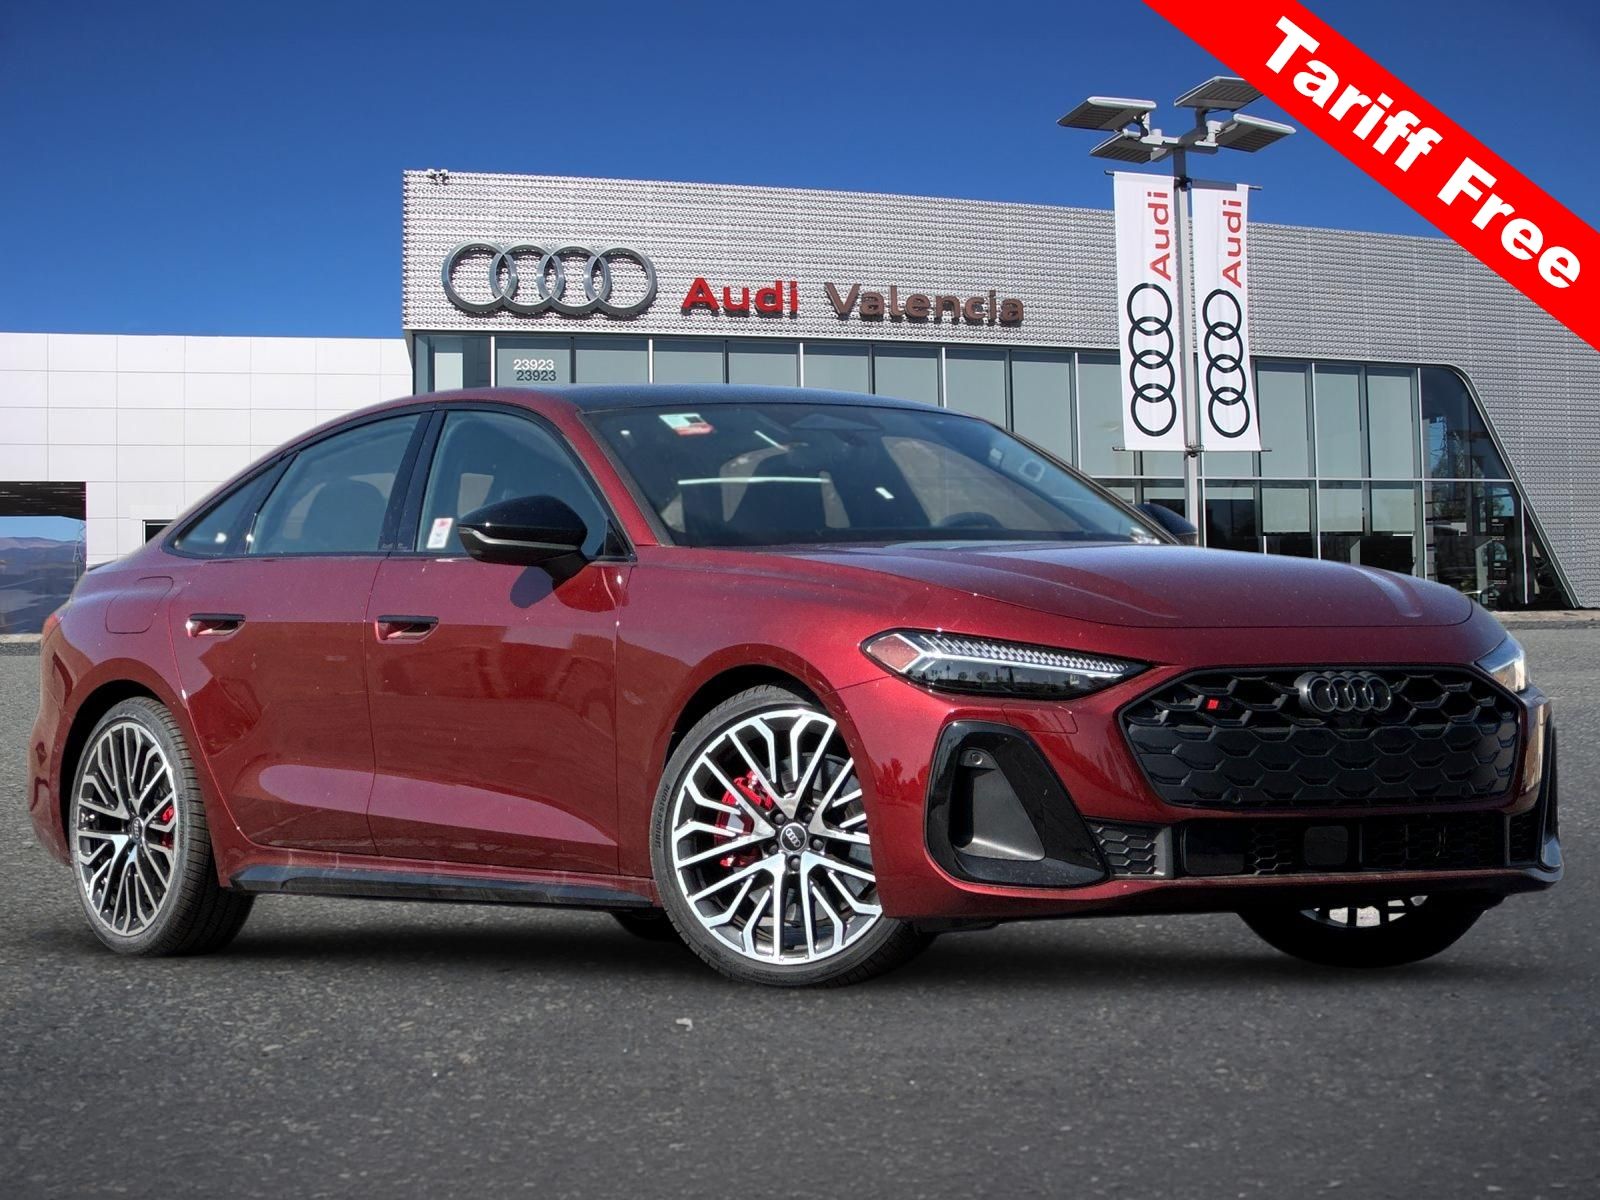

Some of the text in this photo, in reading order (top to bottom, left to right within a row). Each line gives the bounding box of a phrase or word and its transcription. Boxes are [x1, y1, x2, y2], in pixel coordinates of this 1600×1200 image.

[1147, 191, 1172, 282] Audi
[1222, 199, 1242, 288] Audi
[681, 277, 1024, 321] Audi Valencia
[513, 358, 554, 370] 23923
[516, 370, 557, 381] 23923
[654, 784, 671, 849] BRIDGESTONE
